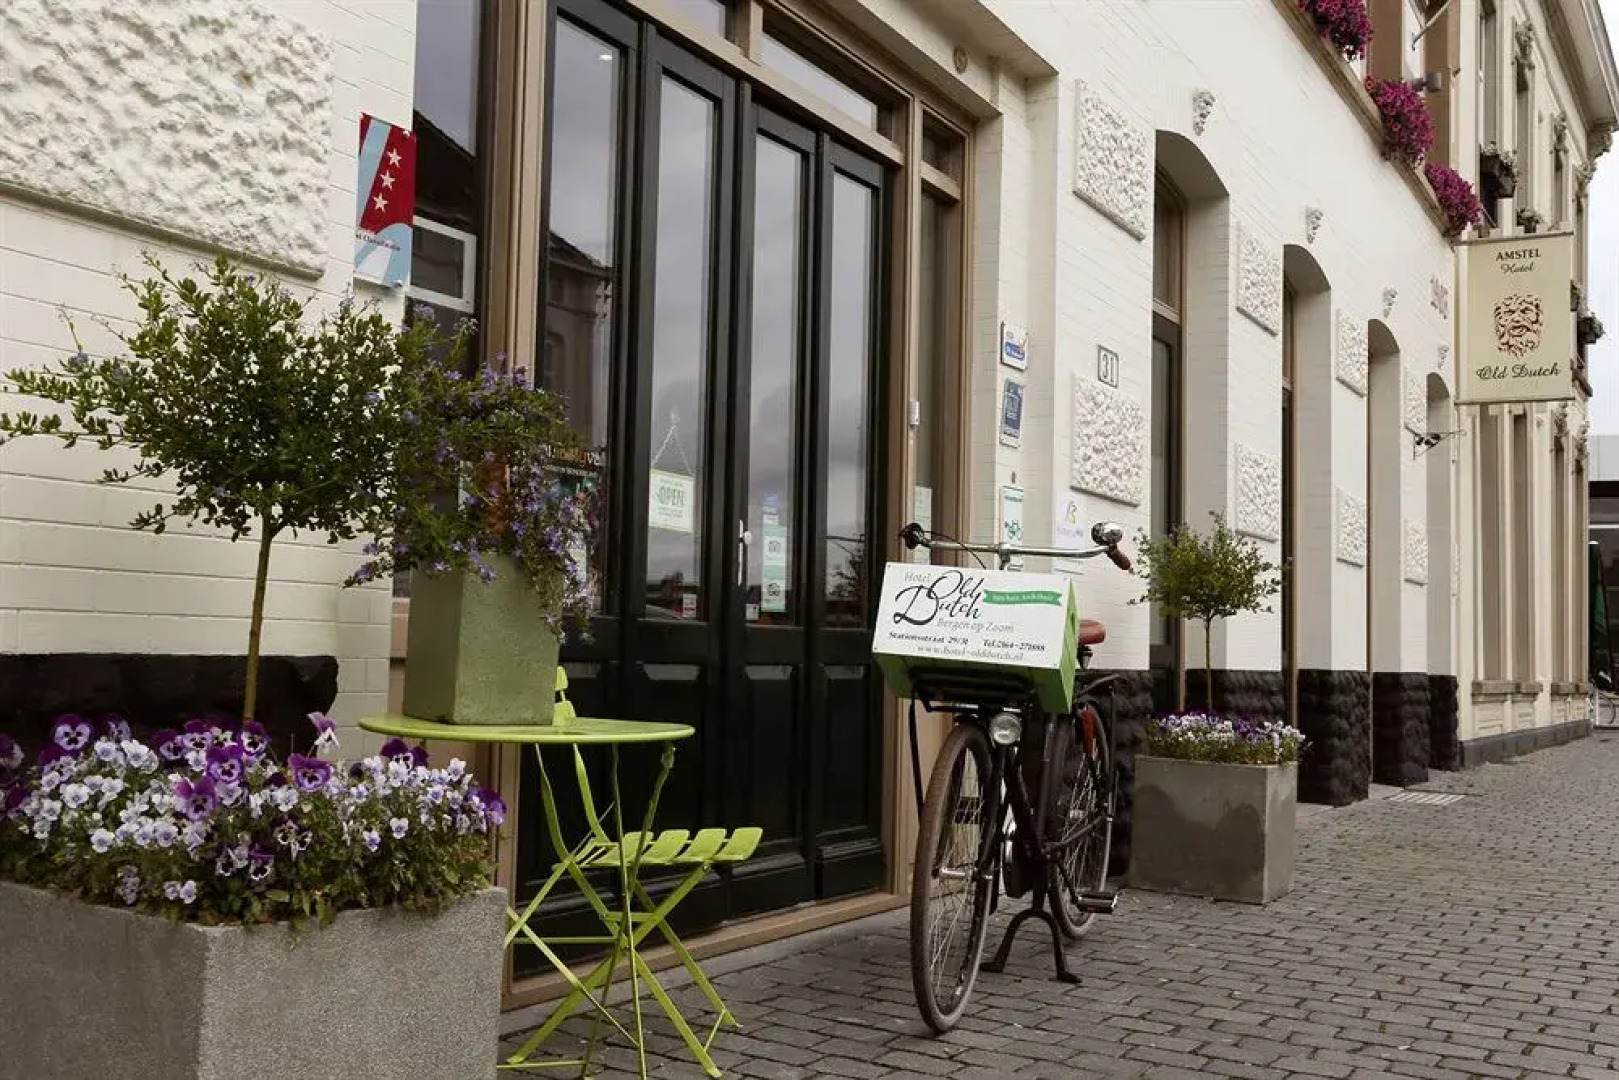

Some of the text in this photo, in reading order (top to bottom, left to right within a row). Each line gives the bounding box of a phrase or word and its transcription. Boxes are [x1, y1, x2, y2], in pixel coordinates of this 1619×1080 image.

[1496, 248, 1541, 261] AMSTEL
[1500, 262, 1534, 273] Hotel
[1102, 353, 1115, 383] 31
[1476, 362, 1561, 380] Old Dutch
[904, 572, 931, 583] Hotel
[926, 570, 985, 599] Old
[893, 585, 983, 625] Dutch
[937, 618, 1014, 634] Bergen op Zoom
